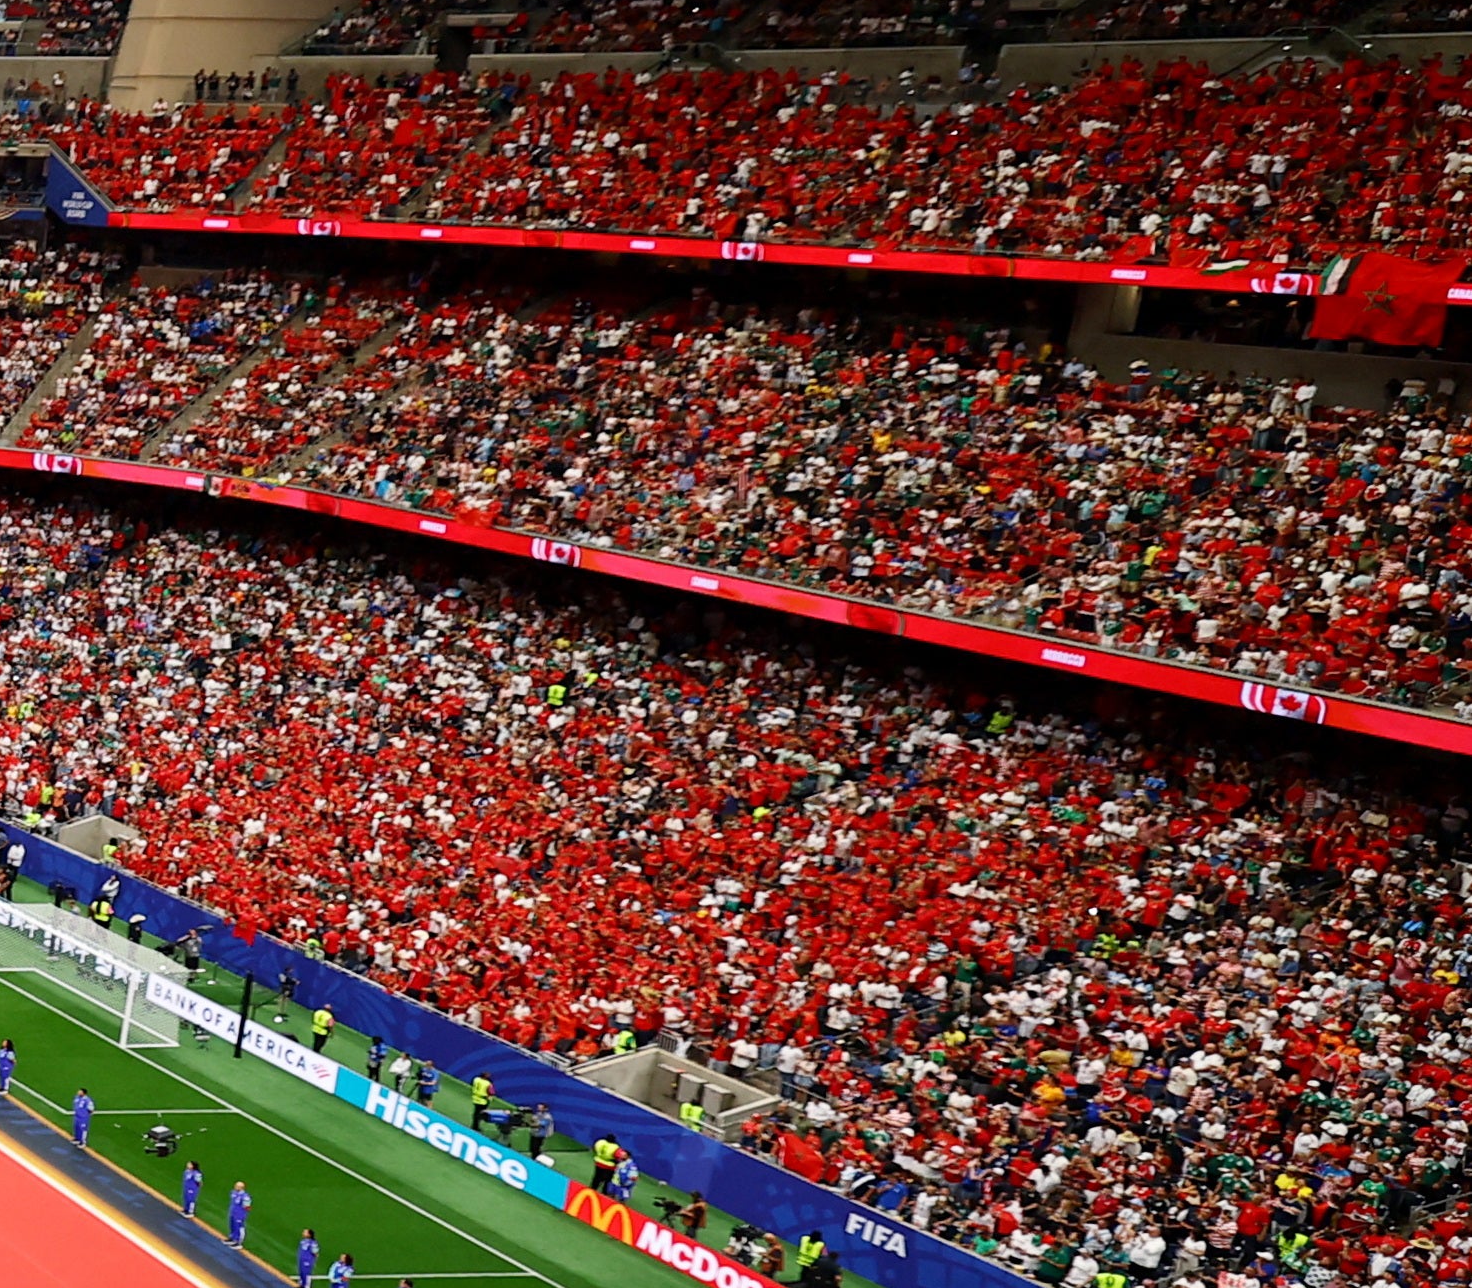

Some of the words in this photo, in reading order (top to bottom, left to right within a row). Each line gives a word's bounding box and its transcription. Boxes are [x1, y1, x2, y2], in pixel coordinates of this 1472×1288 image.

[152, 981, 198, 1023] BANK
[202, 1005, 223, 1030] OF
[364, 1078, 528, 1190] Hisense
[844, 1211, 908, 1258] FIFA
